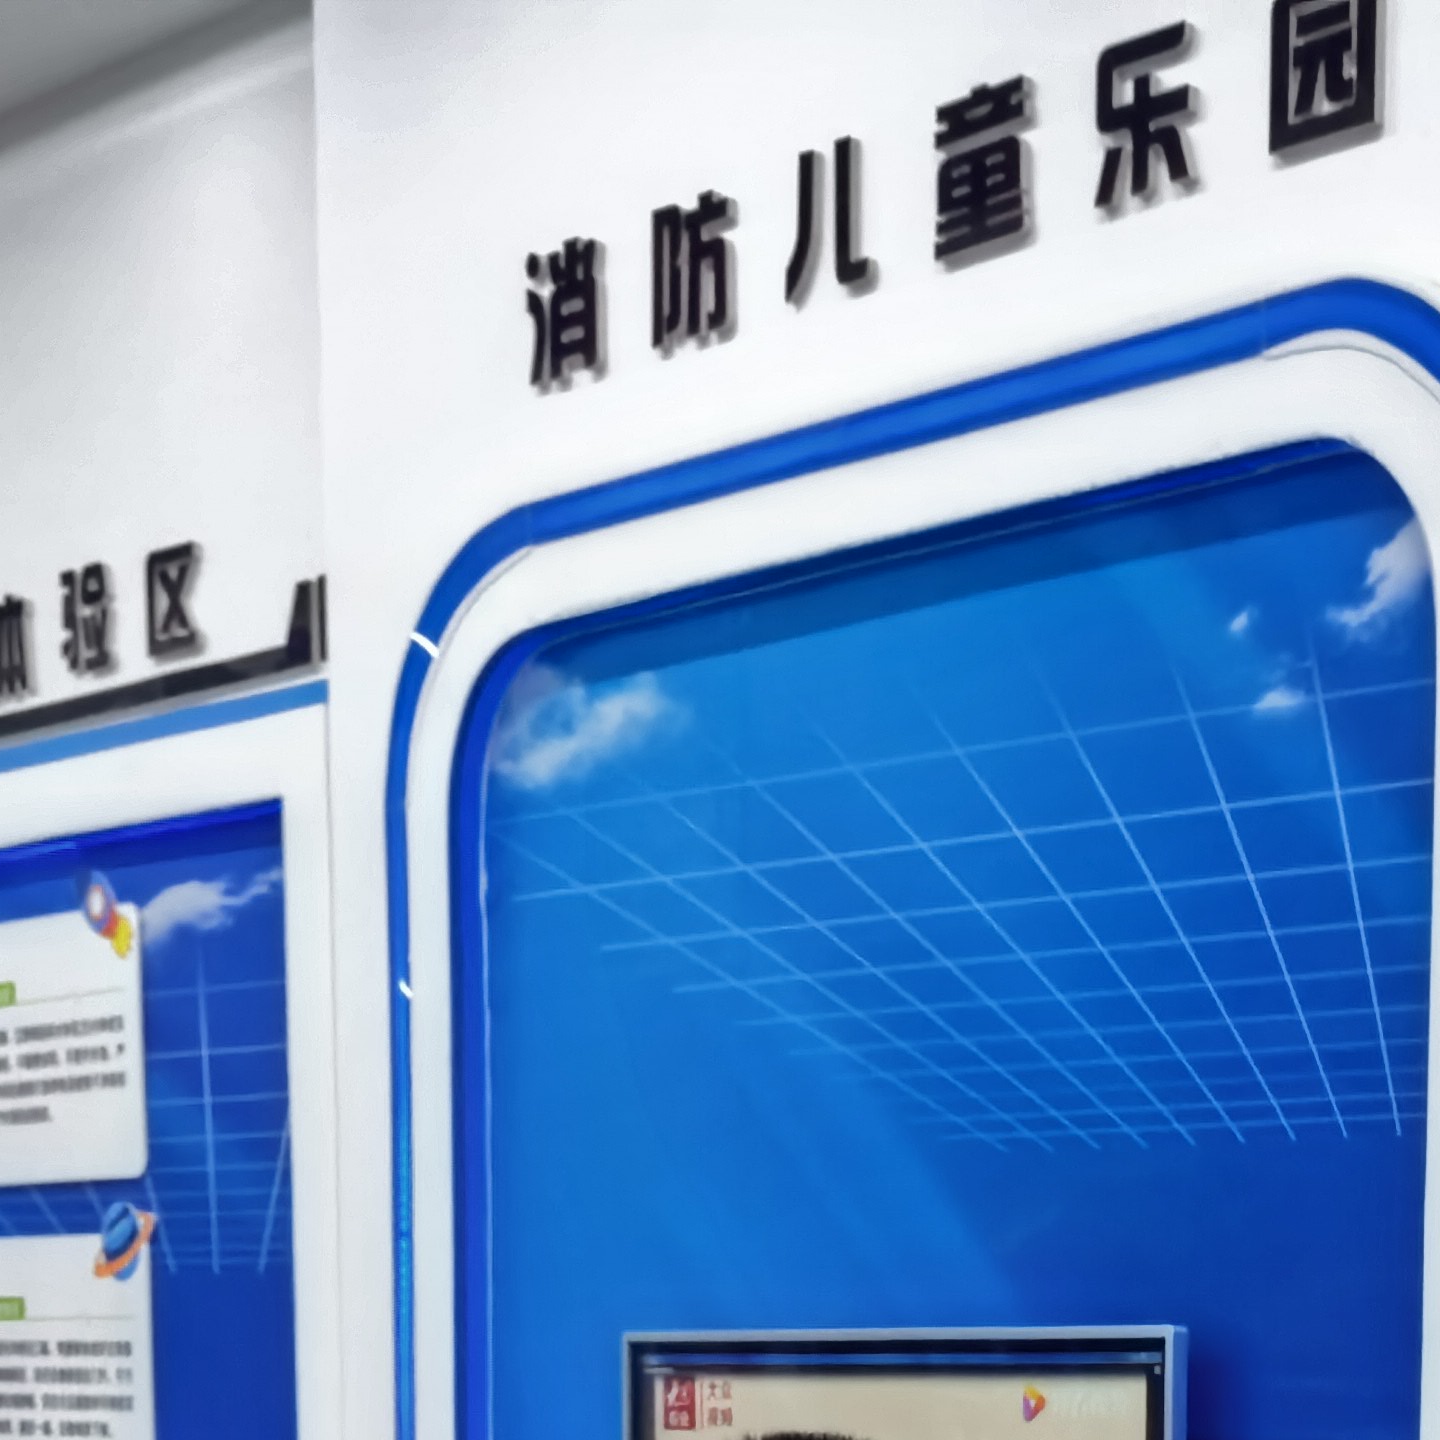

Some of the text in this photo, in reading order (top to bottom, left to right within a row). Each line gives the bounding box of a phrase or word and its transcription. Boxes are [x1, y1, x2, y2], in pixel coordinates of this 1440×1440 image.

[524, 0, 1384, 394] 消防儿童乐园
